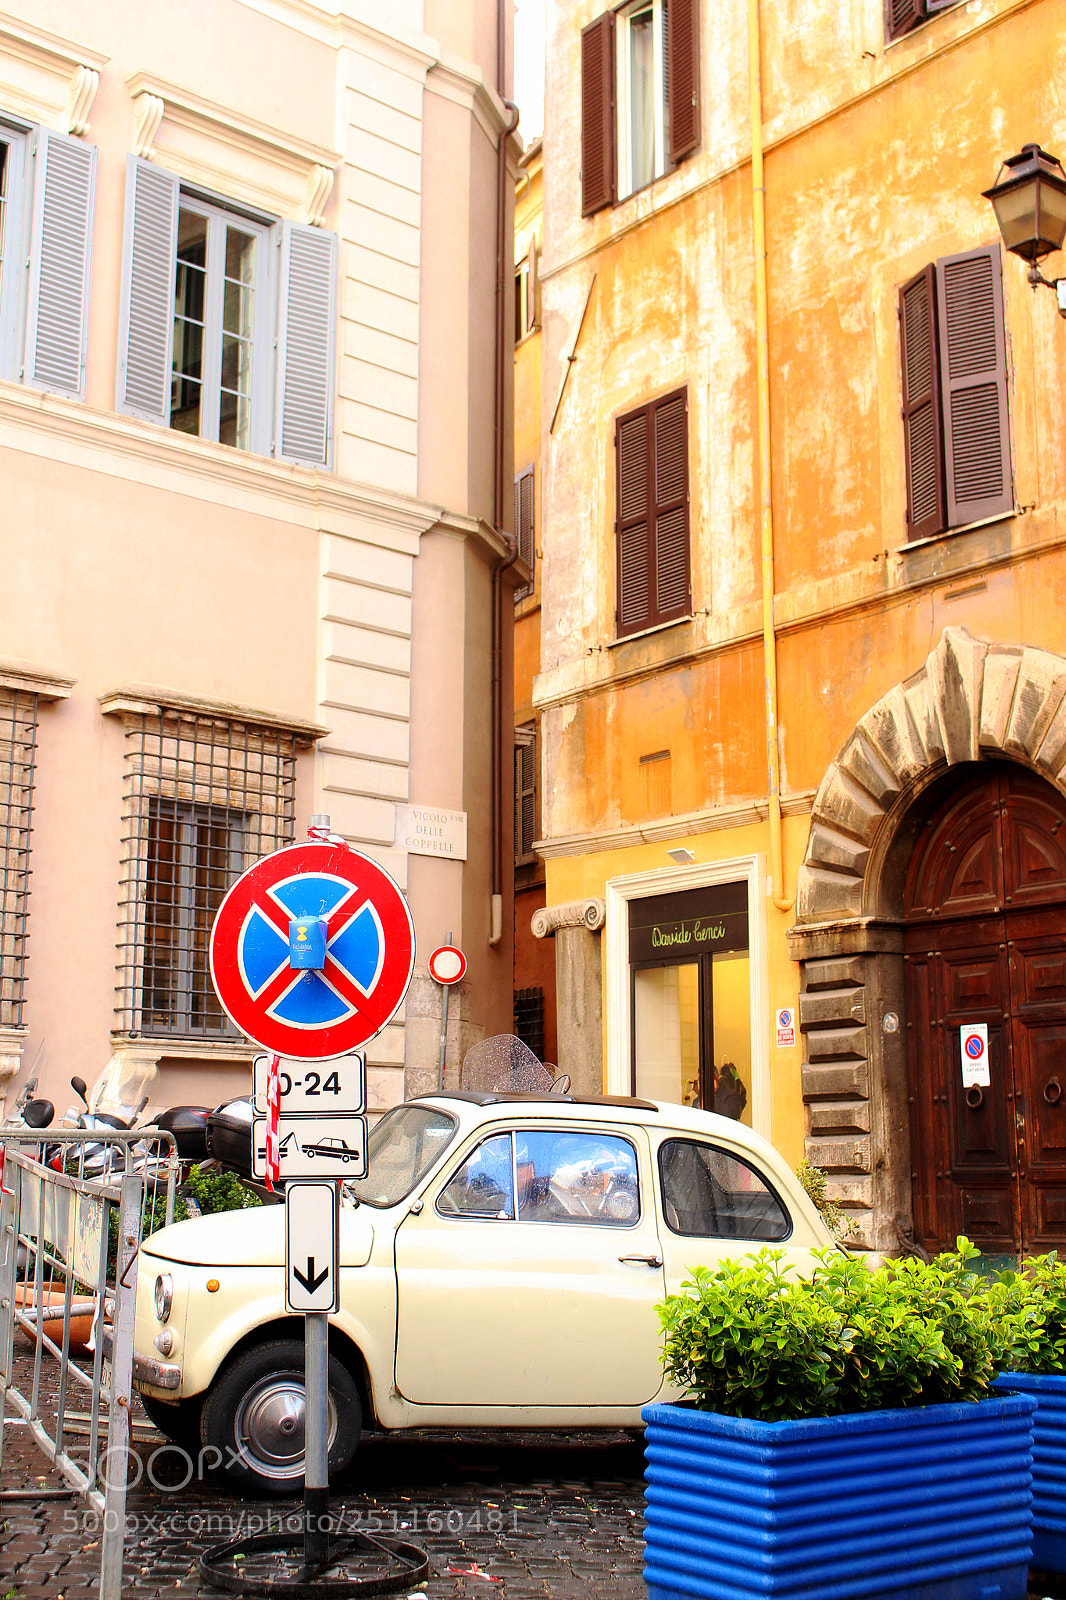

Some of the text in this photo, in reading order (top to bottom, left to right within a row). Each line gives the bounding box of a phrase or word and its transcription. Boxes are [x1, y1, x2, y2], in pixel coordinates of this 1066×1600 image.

[413, 810, 447, 823] VICOLO
[416, 824, 443, 837] DELLE
[405, 837, 454, 852] COPPELLE
[652, 921, 725, 947] Davide Cenci
